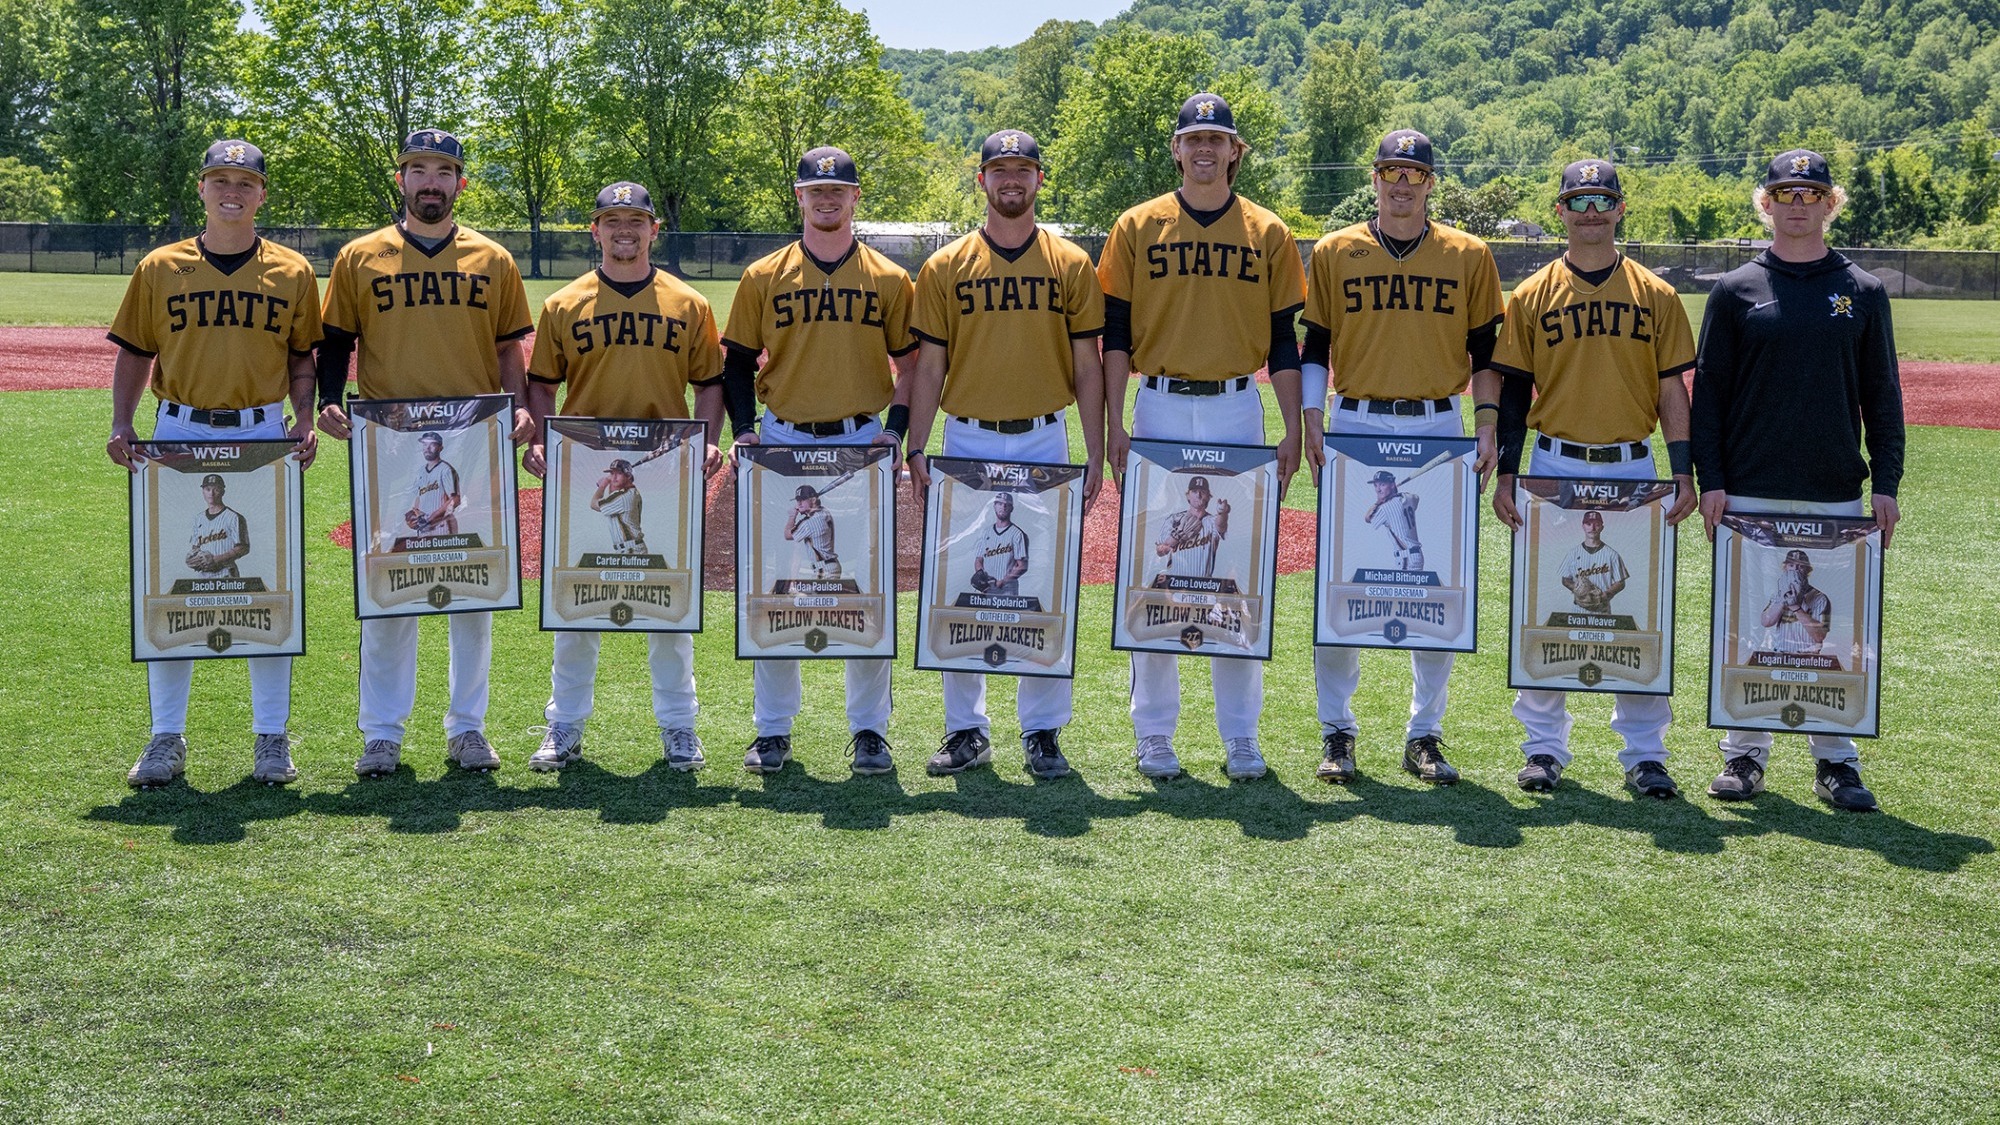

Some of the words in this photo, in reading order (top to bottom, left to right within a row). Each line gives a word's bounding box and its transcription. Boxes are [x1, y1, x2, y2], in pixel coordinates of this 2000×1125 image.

[1147, 241, 1261, 282] STATE
[371, 271, 490, 313] STATE
[955, 276, 1064, 315] STATE
[1343, 275, 1458, 315] STATE
[167, 290, 289, 335] STATE
[772, 288, 883, 329] STATE
[1540, 300, 1652, 348] STATE
[572, 312, 687, 356] STATE
[408, 404, 454, 418] WVSU
[604, 425, 648, 438] WVSU
[192, 447, 240, 460] WVSU
[1377, 442, 1422, 455] WVSU
[793, 451, 837, 464] WVSU
[1182, 449, 1225, 462] WVSU
[985, 464, 1029, 480] WVSU
[1573, 484, 1618, 498] WVSU
[1775, 522, 1822, 535] WVSU
[406, 539, 431, 549] Brodie
[432, 537, 468, 547] Guenther
[413, 554, 431, 563] THIRD
[432, 553, 463, 562] BASEMAN
[596, 556, 620, 565] Carter
[622, 556, 650, 566] Ruffner
[388, 567, 435, 592] YELLOW
[438, 564, 488, 586] JACKETS
[605, 572, 641, 580] OUTFIELDER
[1365, 572, 1394, 582] Michael
[1395, 573, 1429, 584] Bittinger
[192, 581, 214, 591] Jacob
[216, 581, 246, 590] Painter
[813, 582, 842, 591] Paulsen
[1170, 579, 1188, 588] Zane
[1190, 580, 1221, 592] Loveday
[435, 592, 443, 603] 17
[573, 584, 619, 606] YELLOW
[622, 585, 671, 608] JACKETS
[1369, 588, 1393, 596] SECOND
[1394, 589, 1424, 597] BASEMAN
[189, 597, 215, 606] SECOND
[217, 596, 248, 605] BASEMAN
[970, 596, 991, 605] Ethan
[992, 597, 1028, 608] Spolarich
[617, 610, 626, 620] 13
[980, 612, 1016, 621] OUTFIELDER
[1146, 604, 1191, 627] YELLOW
[1348, 599, 1393, 621] YELLOW
[1396, 602, 1444, 625] JACKETS
[167, 610, 215, 634] YELLOW
[219, 608, 271, 631] JACKETS
[768, 611, 814, 633] YELLOW
[816, 611, 864, 632] JACKETS
[1568, 615, 1586, 625] Evan
[1588, 616, 1616, 626] Weaver
[950, 623, 994, 645] YELLOW
[996, 626, 1044, 650] JACKETS
[1390, 626, 1400, 637] 18
[1578, 632, 1605, 640] CATCHER
[215, 635, 223, 646] 11
[813, 635, 819, 646] 7
[992, 651, 998, 661] 6
[1542, 643, 1586, 664] YELLOW
[1590, 645, 1641, 670] JACKETS
[1758, 654, 1782, 664] Logan
[1784, 655, 1832, 668] Lingenfelter
[1585, 670, 1595, 680] 15
[1781, 672, 1808, 681] PITCHER
[1743, 682, 1790, 704] YELLOW
[1793, 685, 1846, 711] JACKETS
[1788, 711, 1798, 721] 12
